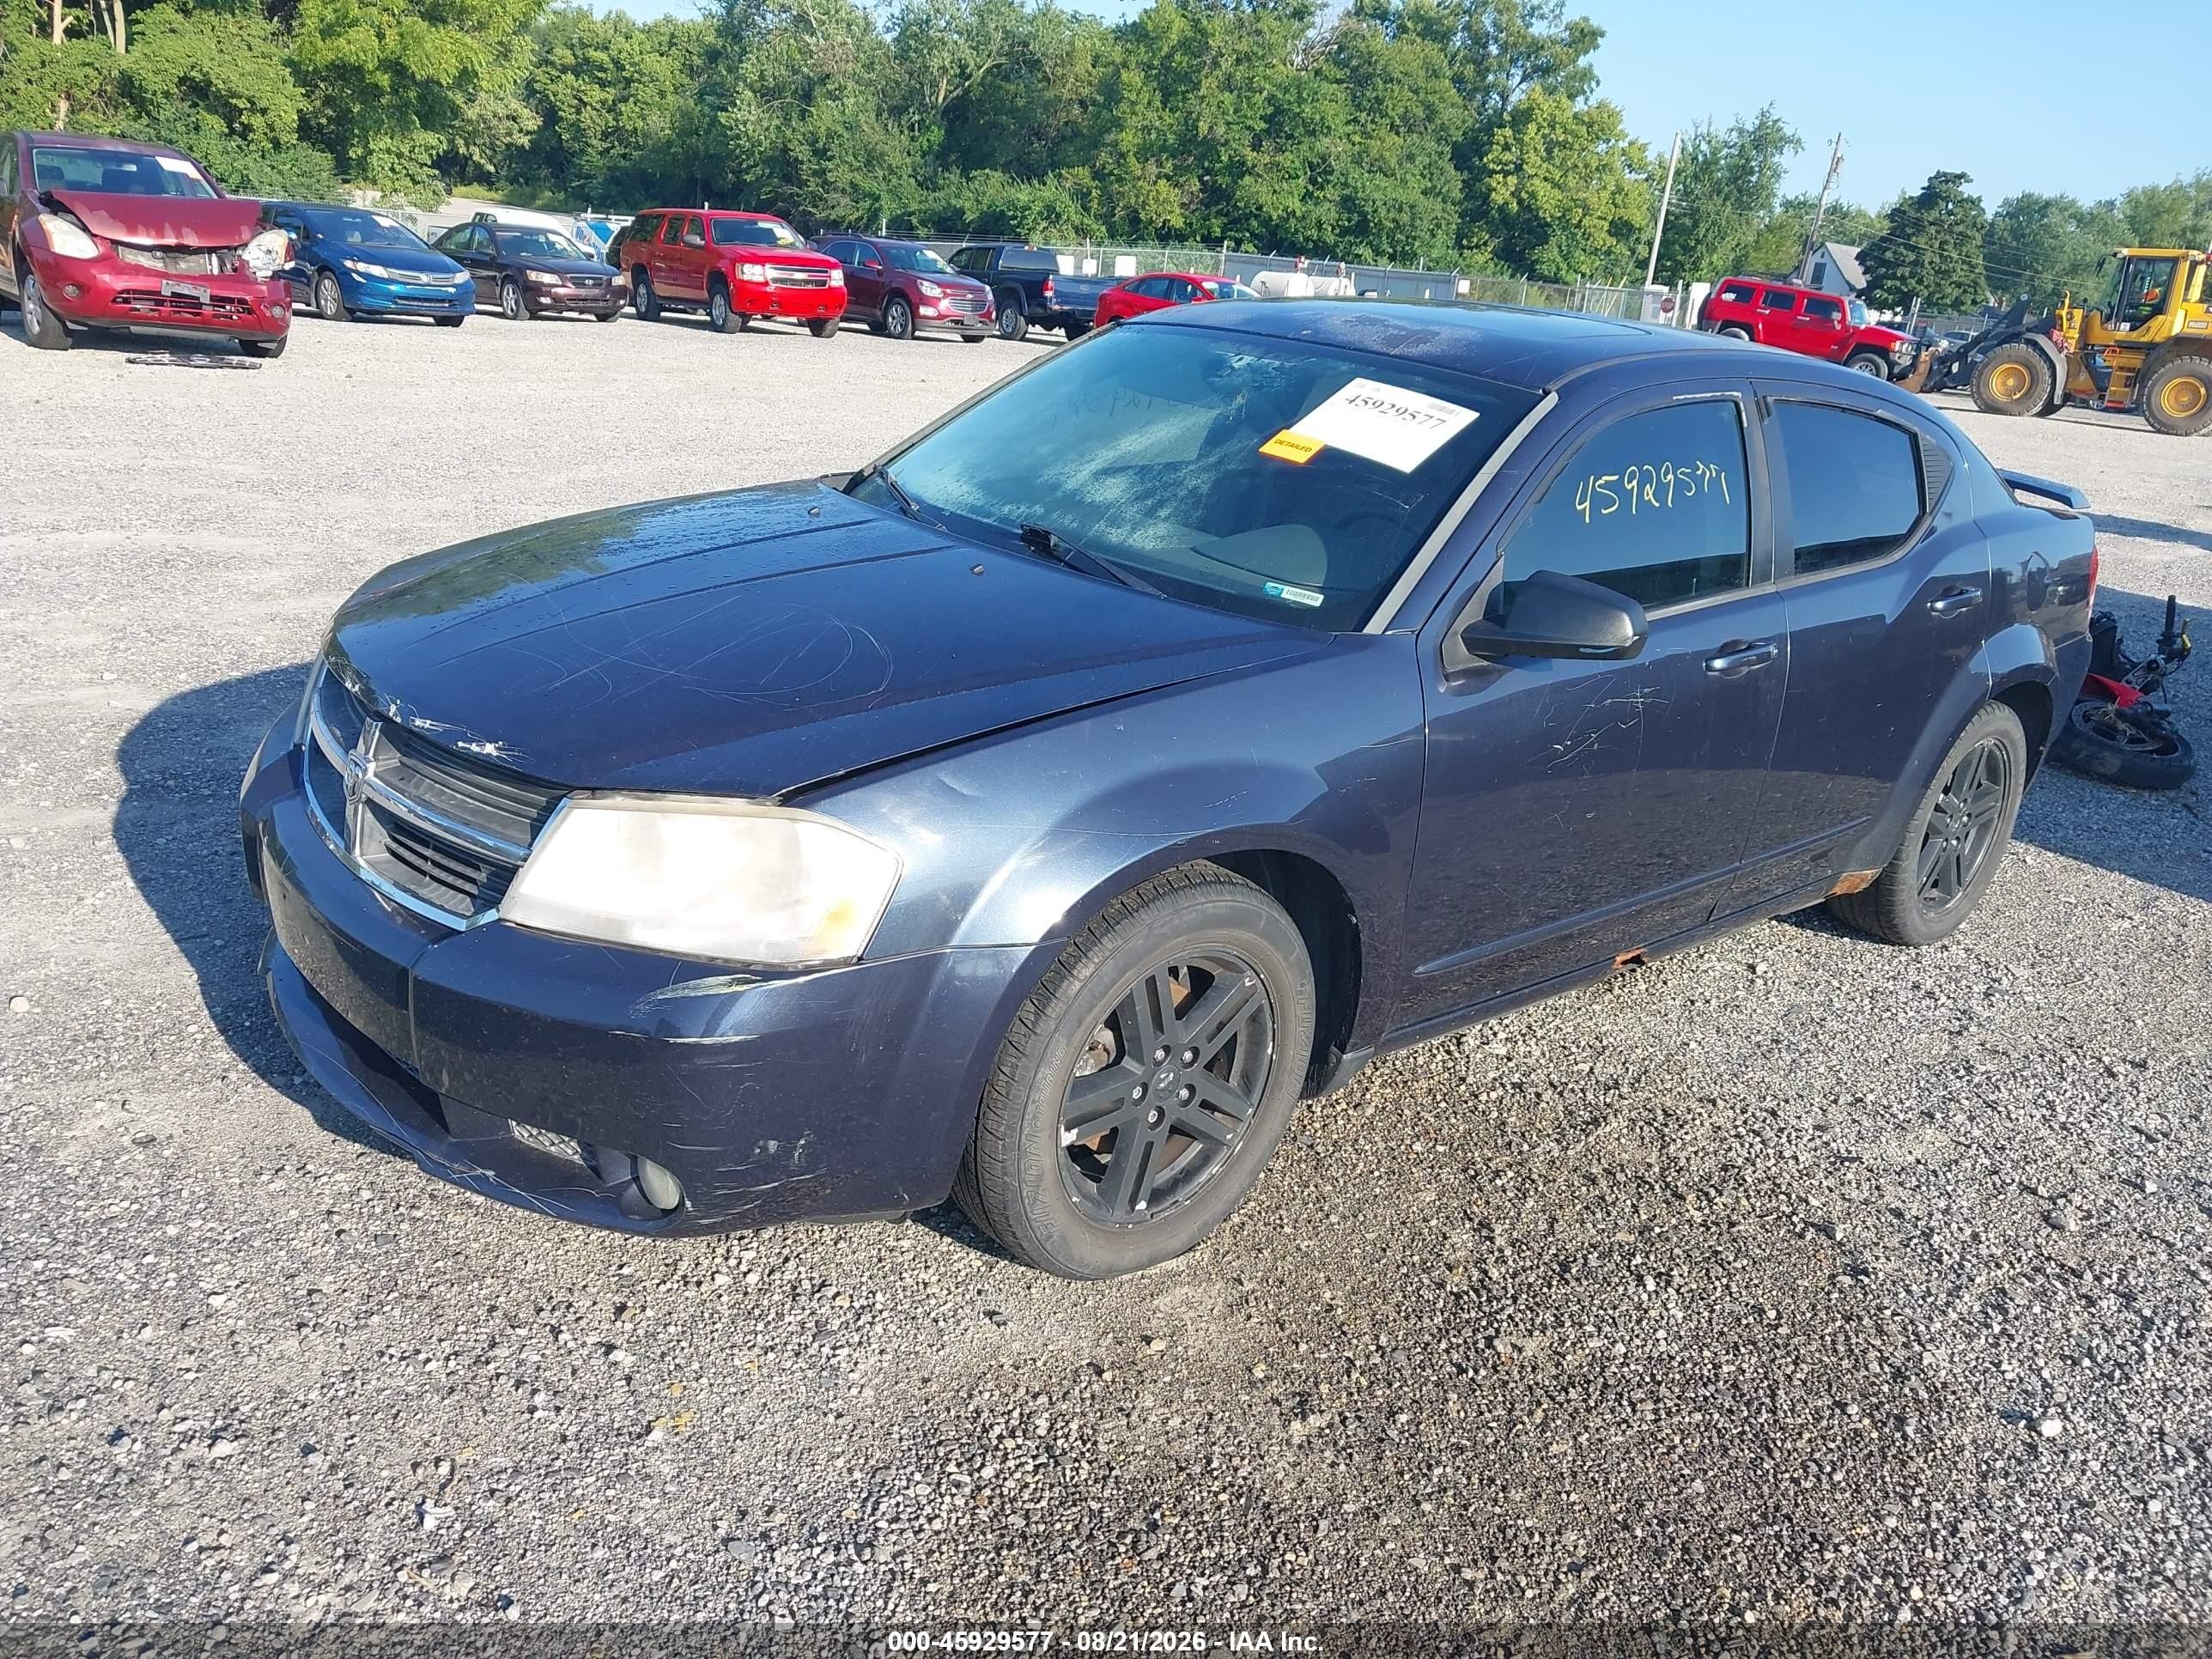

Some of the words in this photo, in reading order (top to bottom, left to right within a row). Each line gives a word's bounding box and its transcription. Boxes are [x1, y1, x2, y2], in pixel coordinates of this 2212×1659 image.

[1346, 393, 1448, 429] 45929577
[1273, 438, 1313, 453] DETAILED
[1035, 1043, 1068, 1117] TOURING
